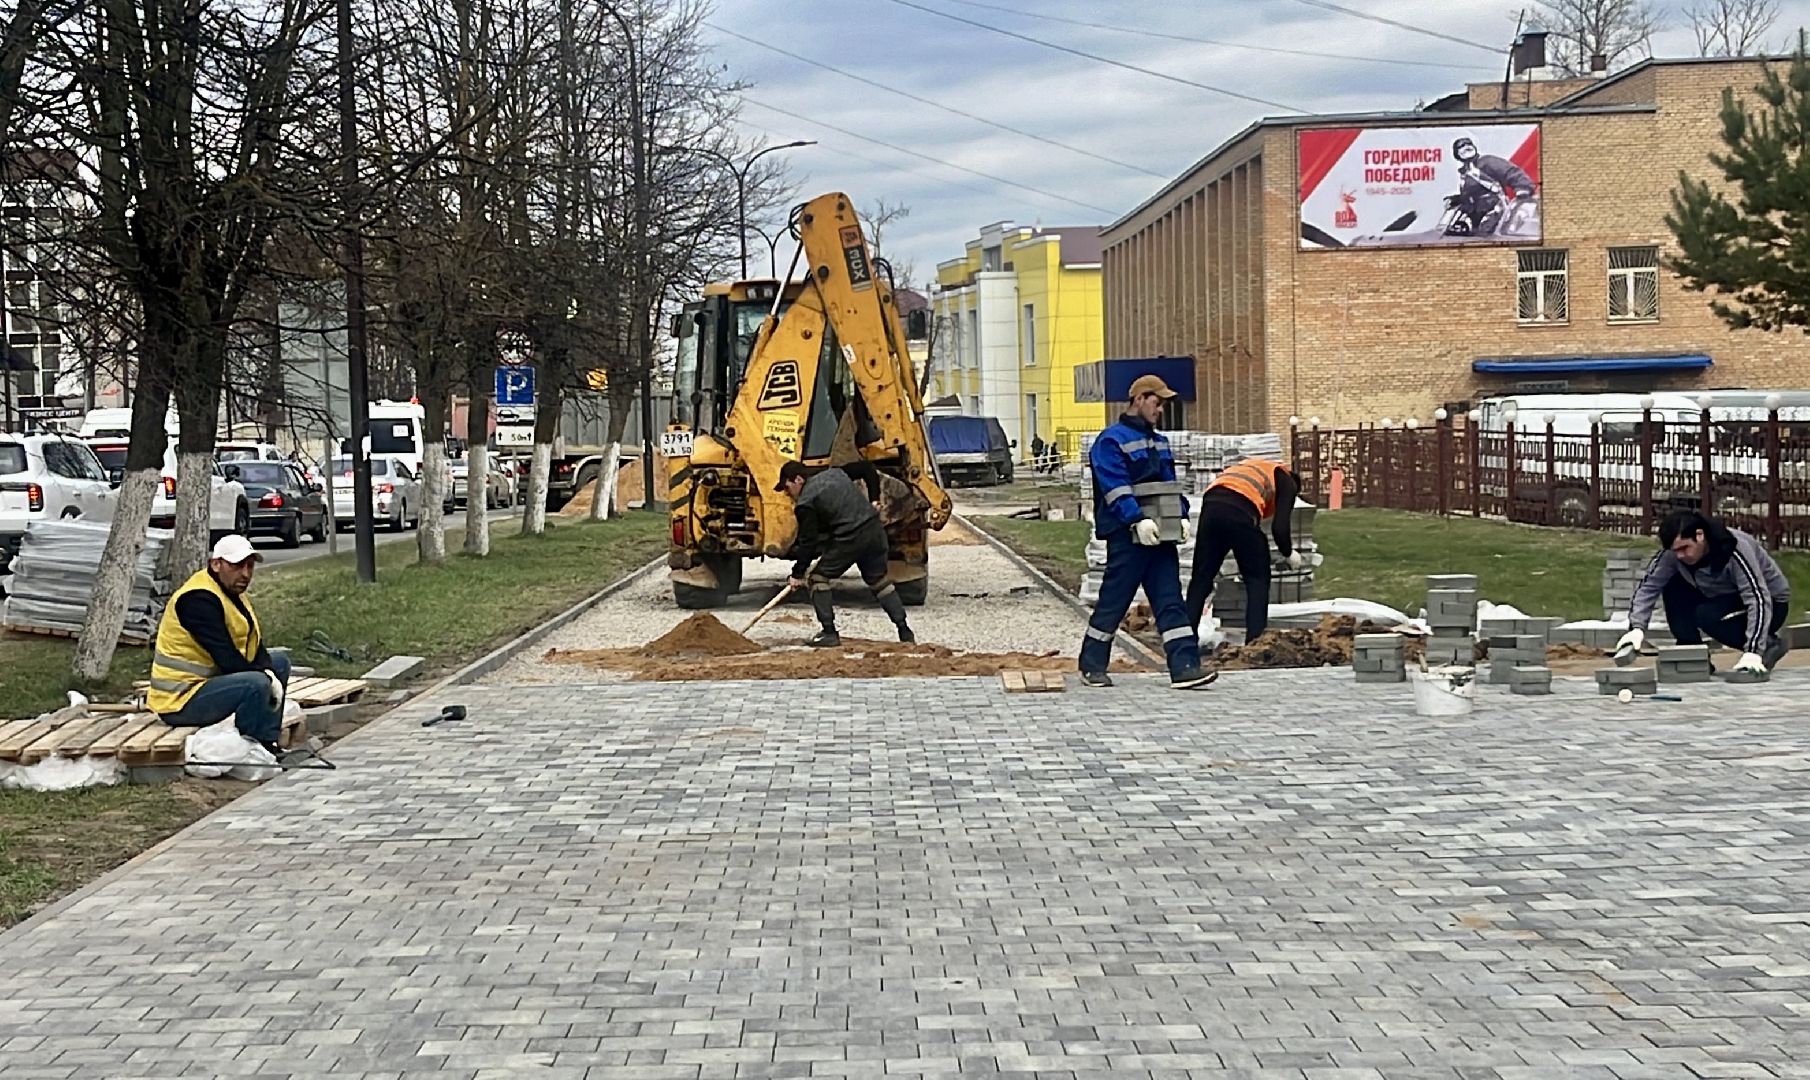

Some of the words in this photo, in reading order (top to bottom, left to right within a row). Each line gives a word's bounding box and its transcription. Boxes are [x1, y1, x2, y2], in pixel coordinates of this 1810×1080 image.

[1364, 148, 1442, 166] ГОРДИМСЯ
[1365, 165, 1435, 184] ПОБЕДОЙ!
[506, 371, 528, 401] P
[763, 364, 798, 404] JCB
[664, 433, 690, 444] 3791
[681, 446, 692, 454] 50
